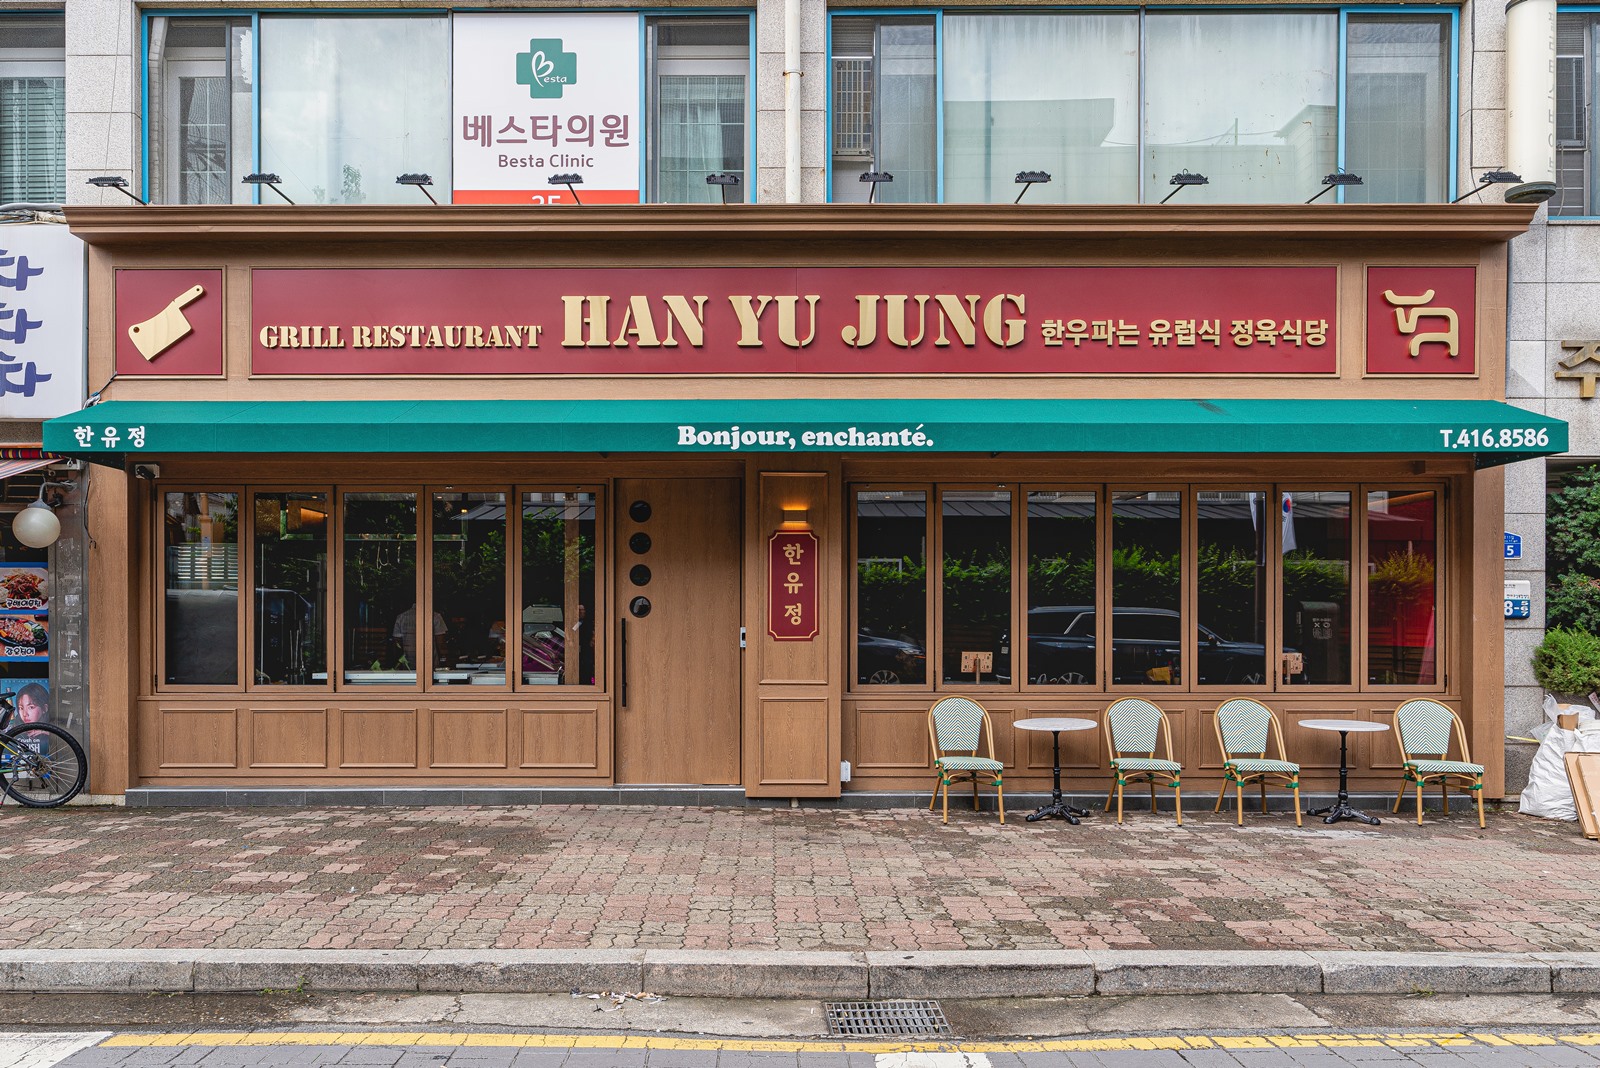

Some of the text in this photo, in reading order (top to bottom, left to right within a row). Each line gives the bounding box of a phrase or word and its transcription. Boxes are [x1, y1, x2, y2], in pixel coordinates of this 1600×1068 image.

[532, 51, 567, 87] Besta
[463, 115, 629, 147] 베스타의원
[498, 154, 594, 168] Besta Clinic
[259, 294, 1027, 348] GRILL RESTAURANT HAN YU JUNG
[1041, 318, 1328, 347] 한우파는 유럽식 정육식당
[677, 424, 934, 450] Bonjour, enchanté.
[1440, 428, 1549, 449] T.416.8586
[783, 543, 804, 626] 한유정
